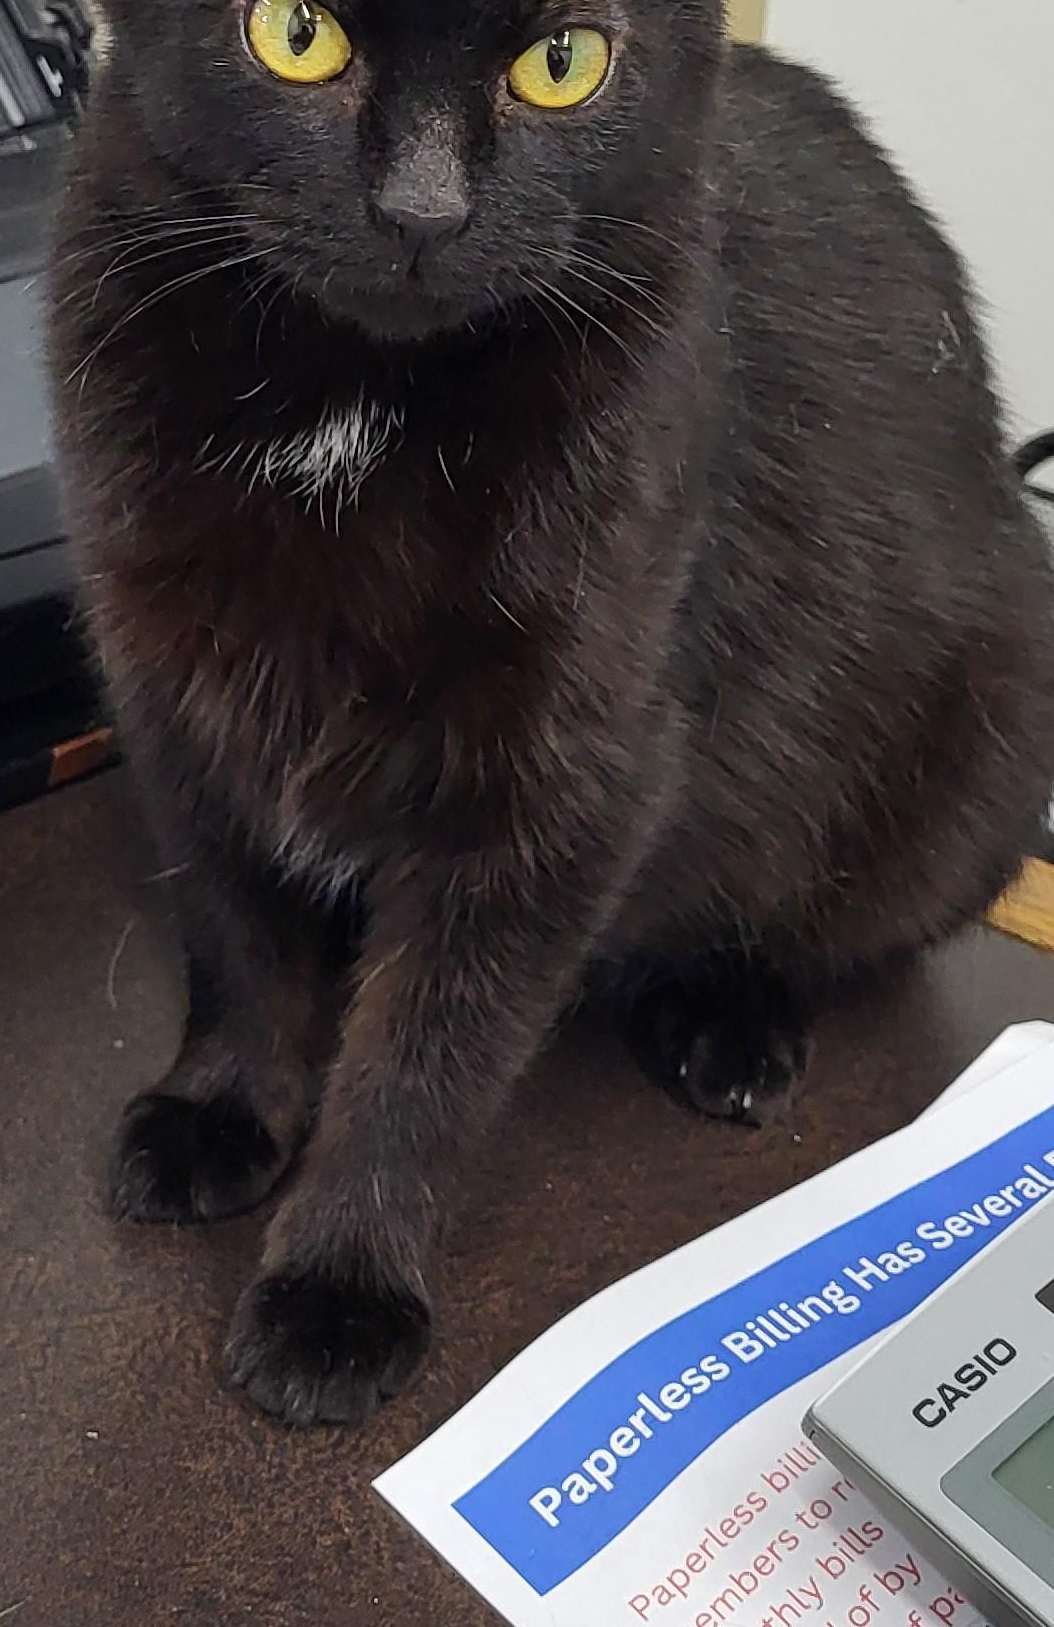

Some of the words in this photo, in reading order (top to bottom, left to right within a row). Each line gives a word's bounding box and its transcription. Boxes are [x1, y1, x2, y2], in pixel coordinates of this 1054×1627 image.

[528, 1349, 732, 1528] Paperless
[720, 1279, 861, 1364] Billing
[842, 1235, 927, 1292] Has
[915, 1163, 1054, 1249] Several
[911, 1336, 1017, 1429] CASIO
[628, 1490, 768, 1622] Paperless
[759, 1439, 823, 1494] billi
[694, 1529, 800, 1627] embers
[794, 1498, 833, 1530] to
[761, 1575, 825, 1627] thly
[815, 1519, 884, 1580] bills
[872, 1553, 922, 1598] by
